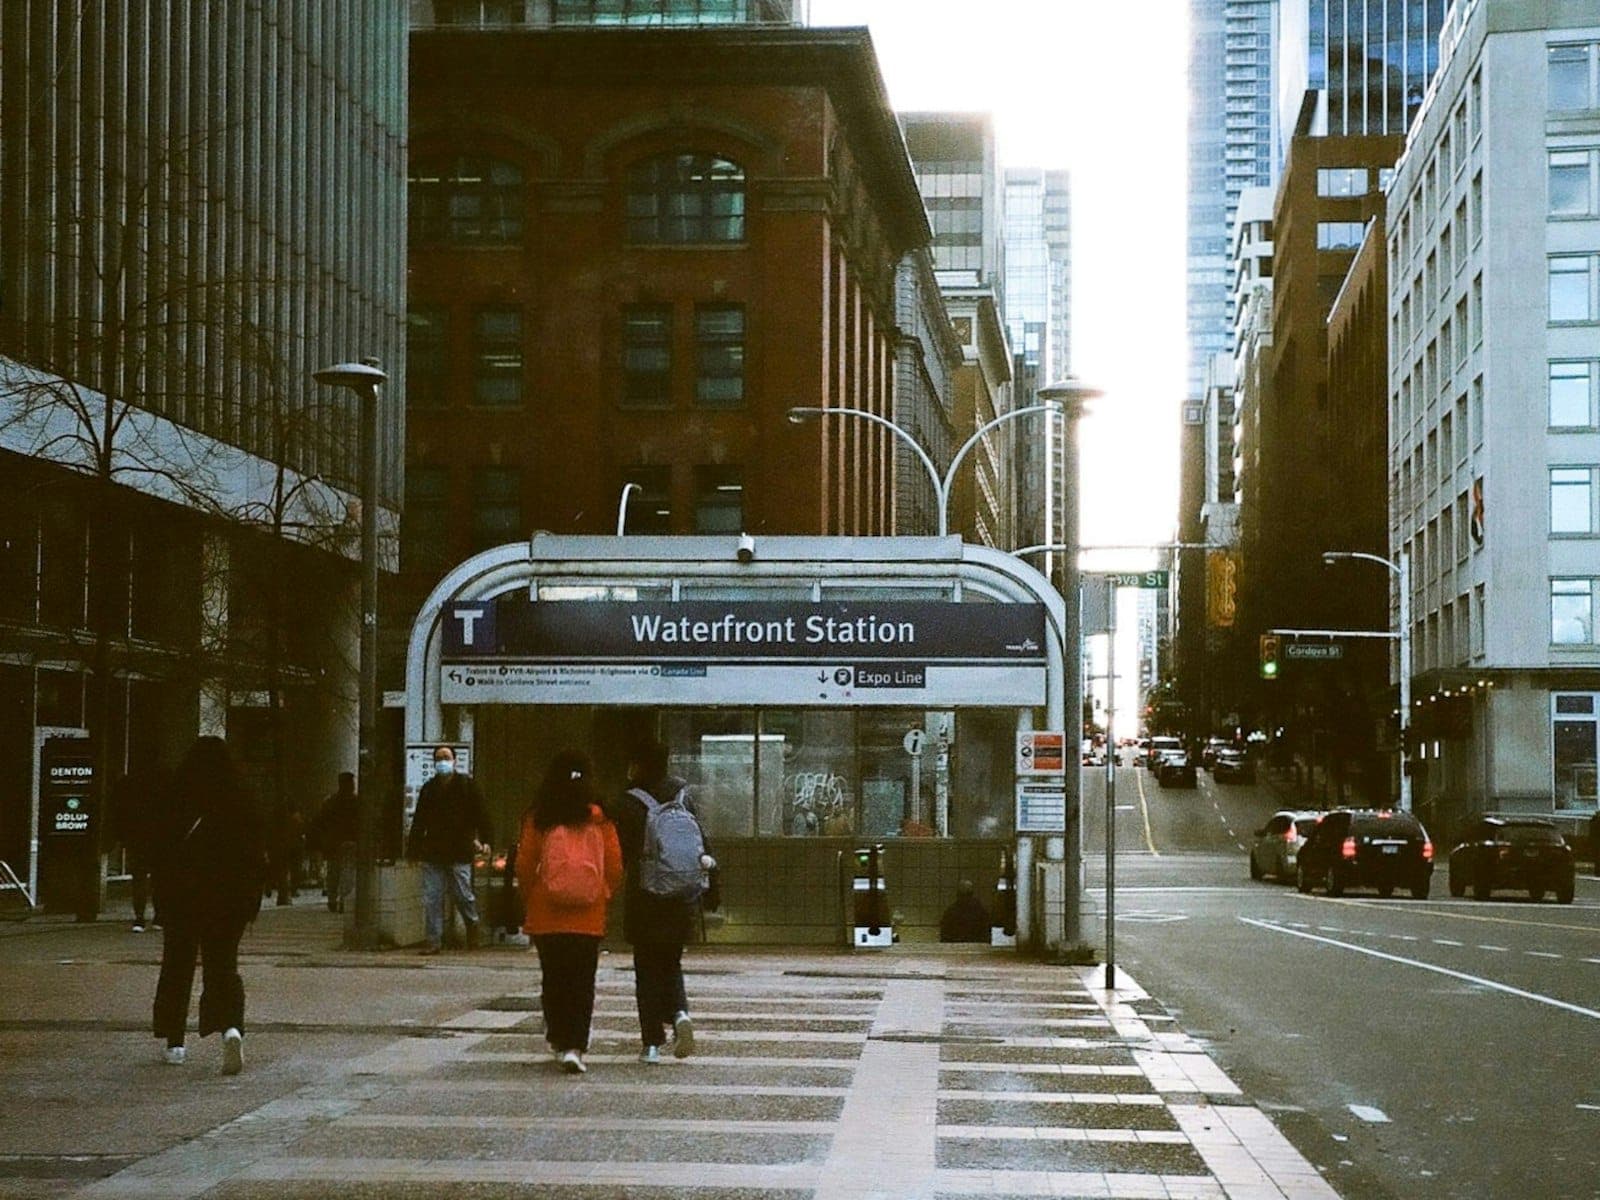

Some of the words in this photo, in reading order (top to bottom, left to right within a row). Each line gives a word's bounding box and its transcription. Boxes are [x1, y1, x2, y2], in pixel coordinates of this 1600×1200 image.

[1146, 573, 1162, 586] St
[454, 609, 484, 645] T
[631, 614, 796, 643] Waterfront
[805, 615, 915, 643] Station
[1288, 646, 1327, 656] Cordova
[1328, 646, 1340, 655] St
[858, 671, 891, 684] Expo
[895, 671, 923, 683] Line
